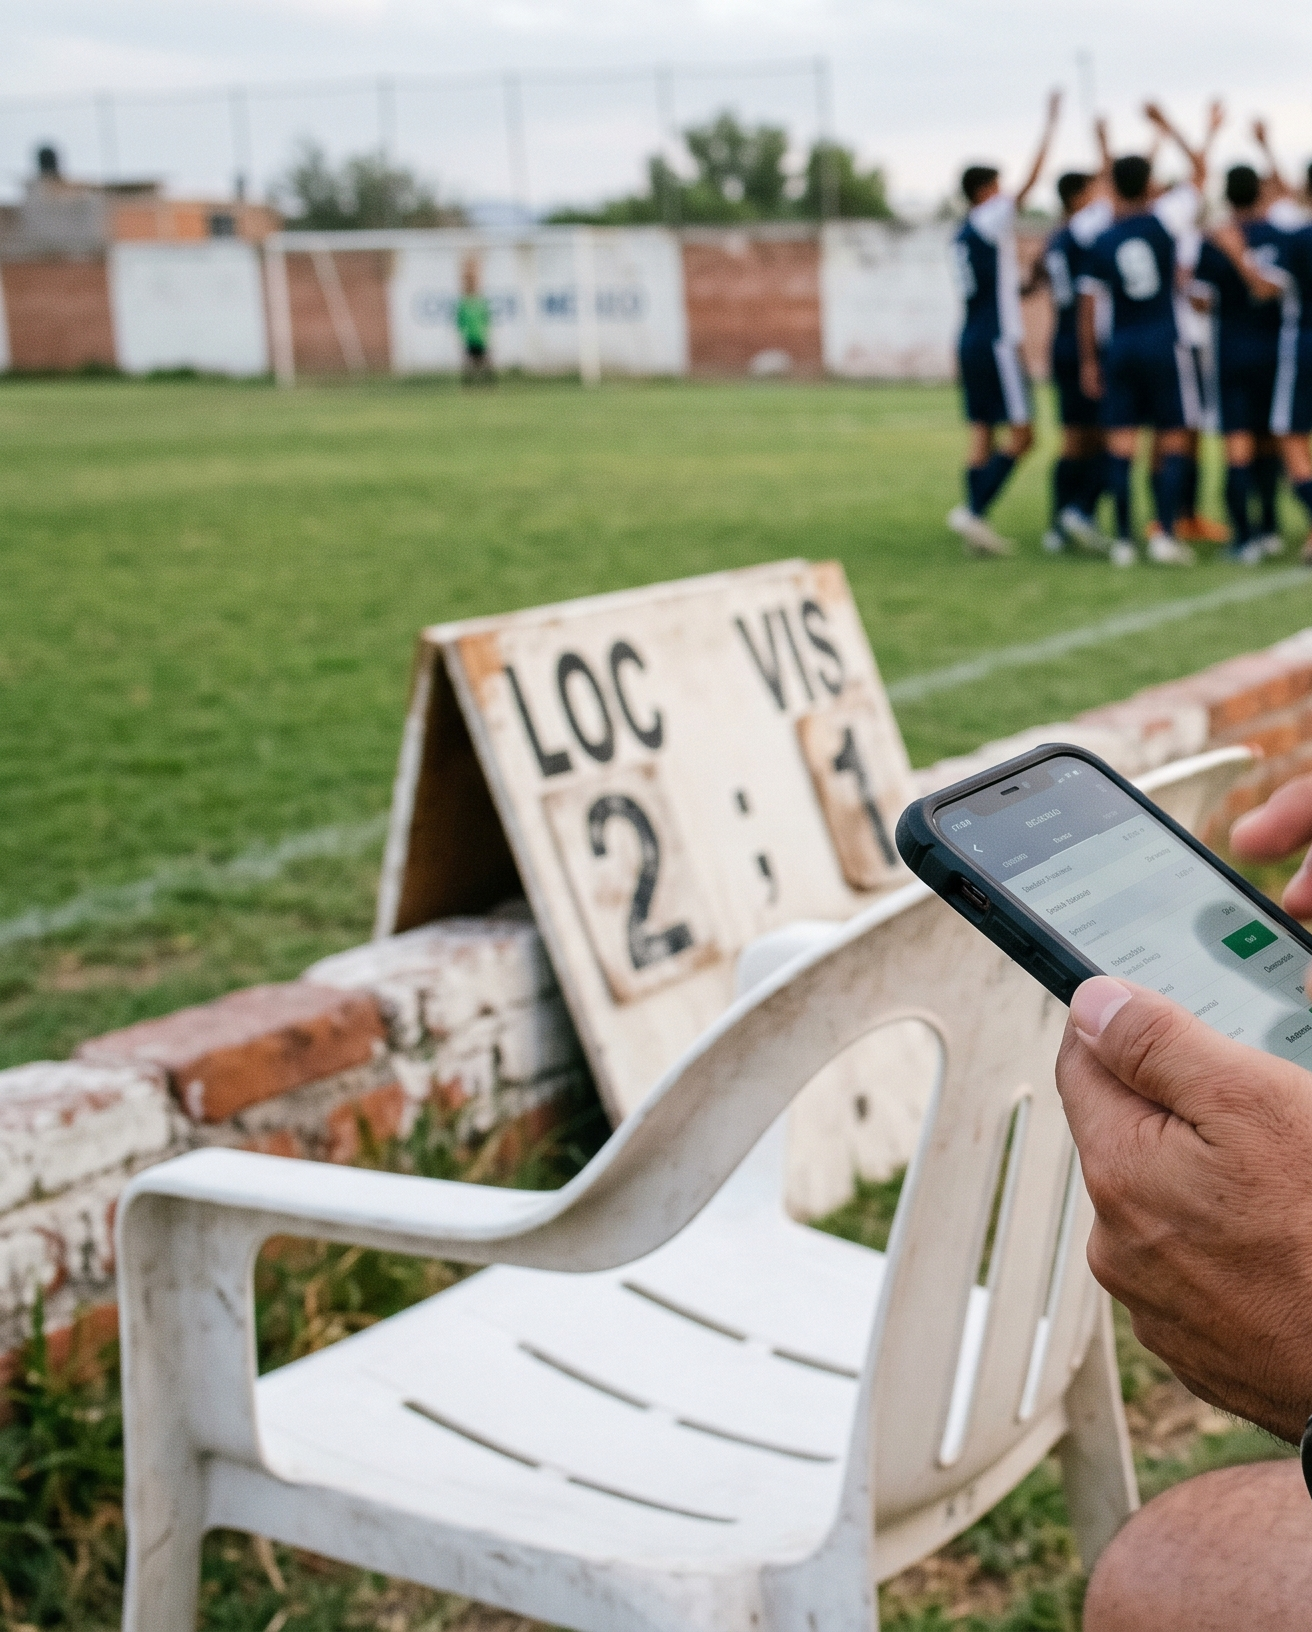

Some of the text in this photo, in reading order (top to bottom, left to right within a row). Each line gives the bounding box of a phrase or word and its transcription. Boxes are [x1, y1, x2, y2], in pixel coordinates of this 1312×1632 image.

[1115, 239, 1160, 299] 9
[504, 599, 846, 778] LOC VIS
[586, 793, 694, 969] 2
[832, 724, 899, 867] 1
